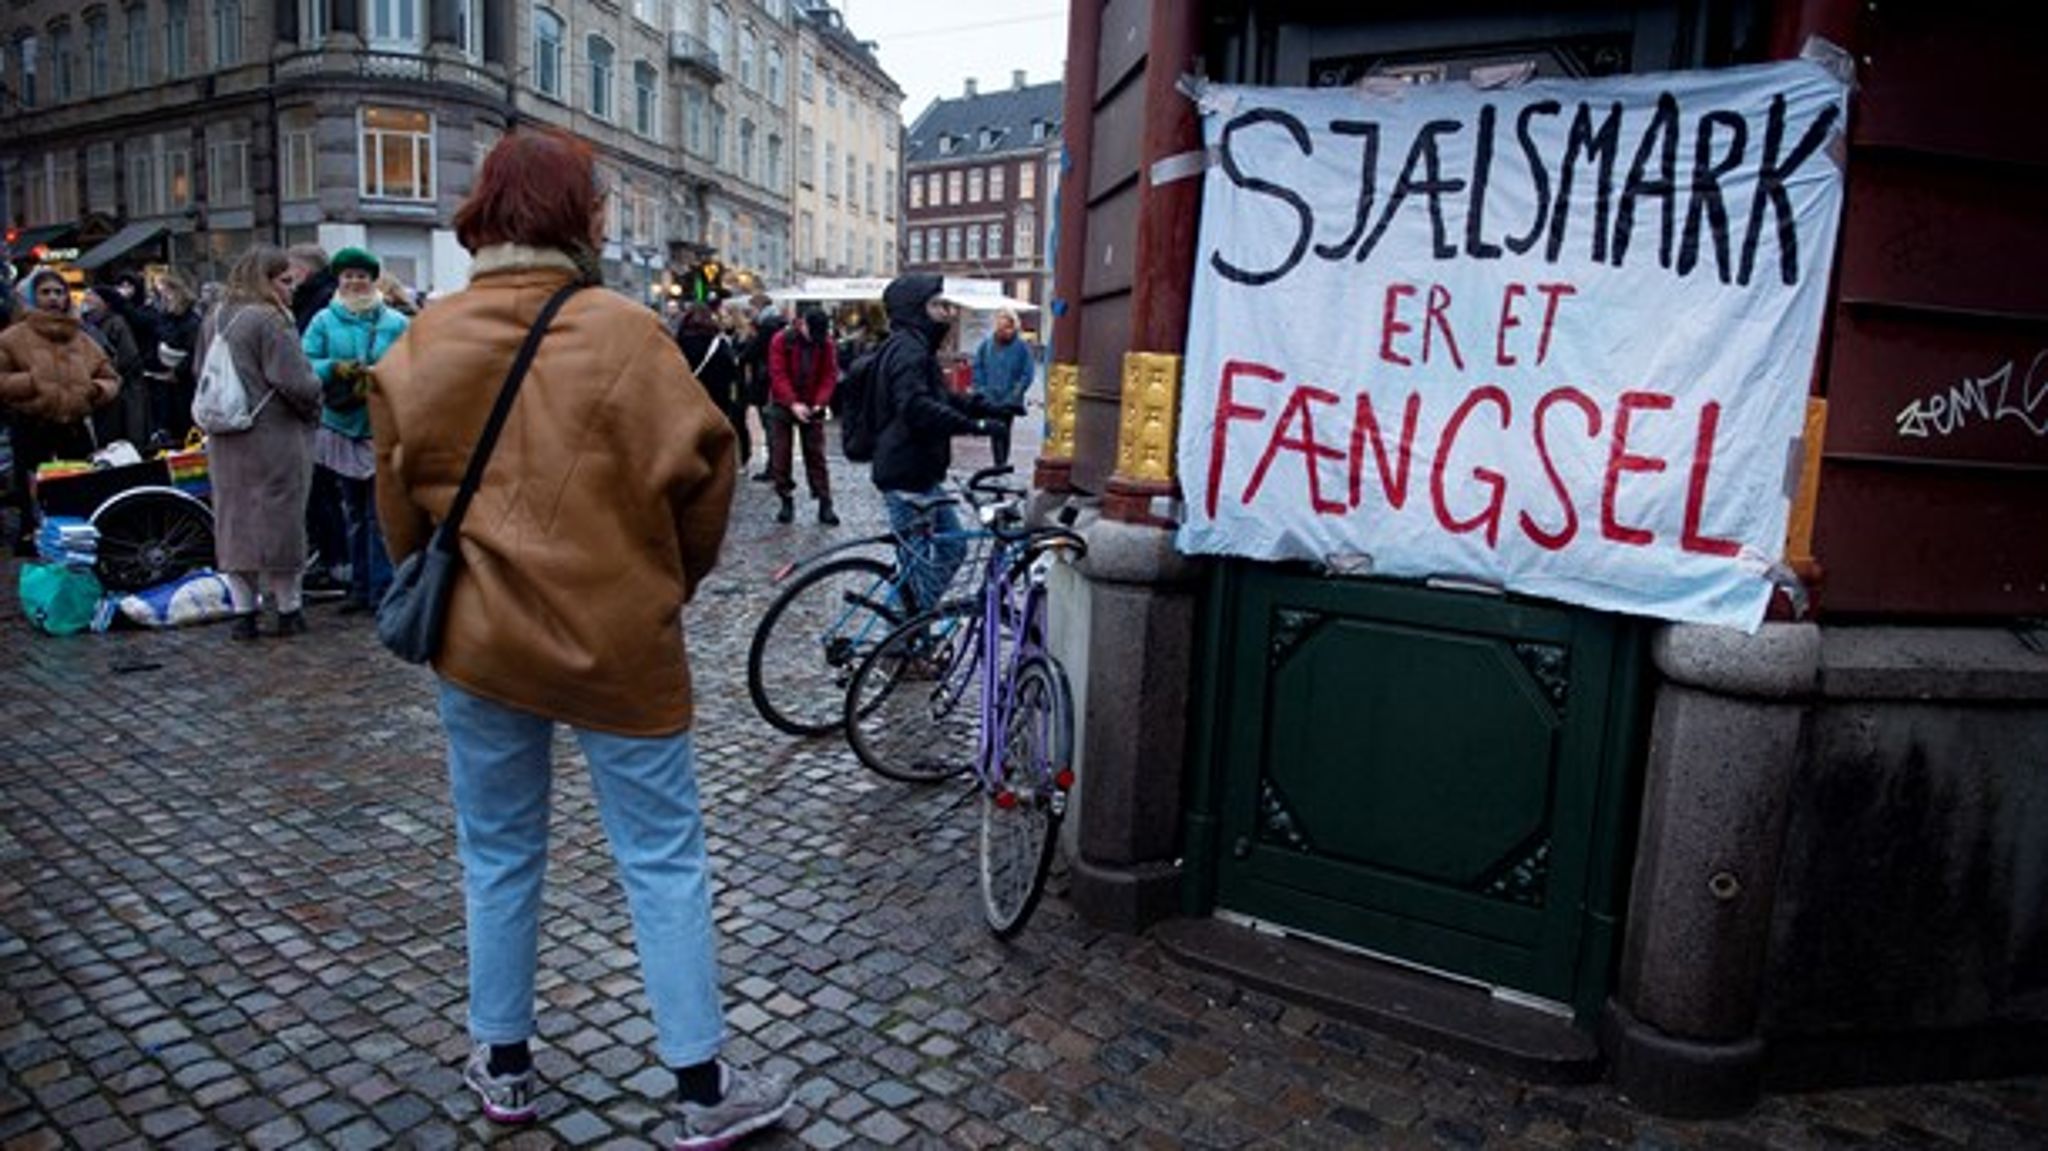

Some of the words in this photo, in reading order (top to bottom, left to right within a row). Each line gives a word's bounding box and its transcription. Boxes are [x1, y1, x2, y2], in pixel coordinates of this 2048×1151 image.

[1211, 91, 1839, 286] SJÆLSMARK
[1379, 284, 1464, 370] ER
[1496, 284, 1576, 367] ET
[1205, 360, 1742, 556] FÆNGSEL
